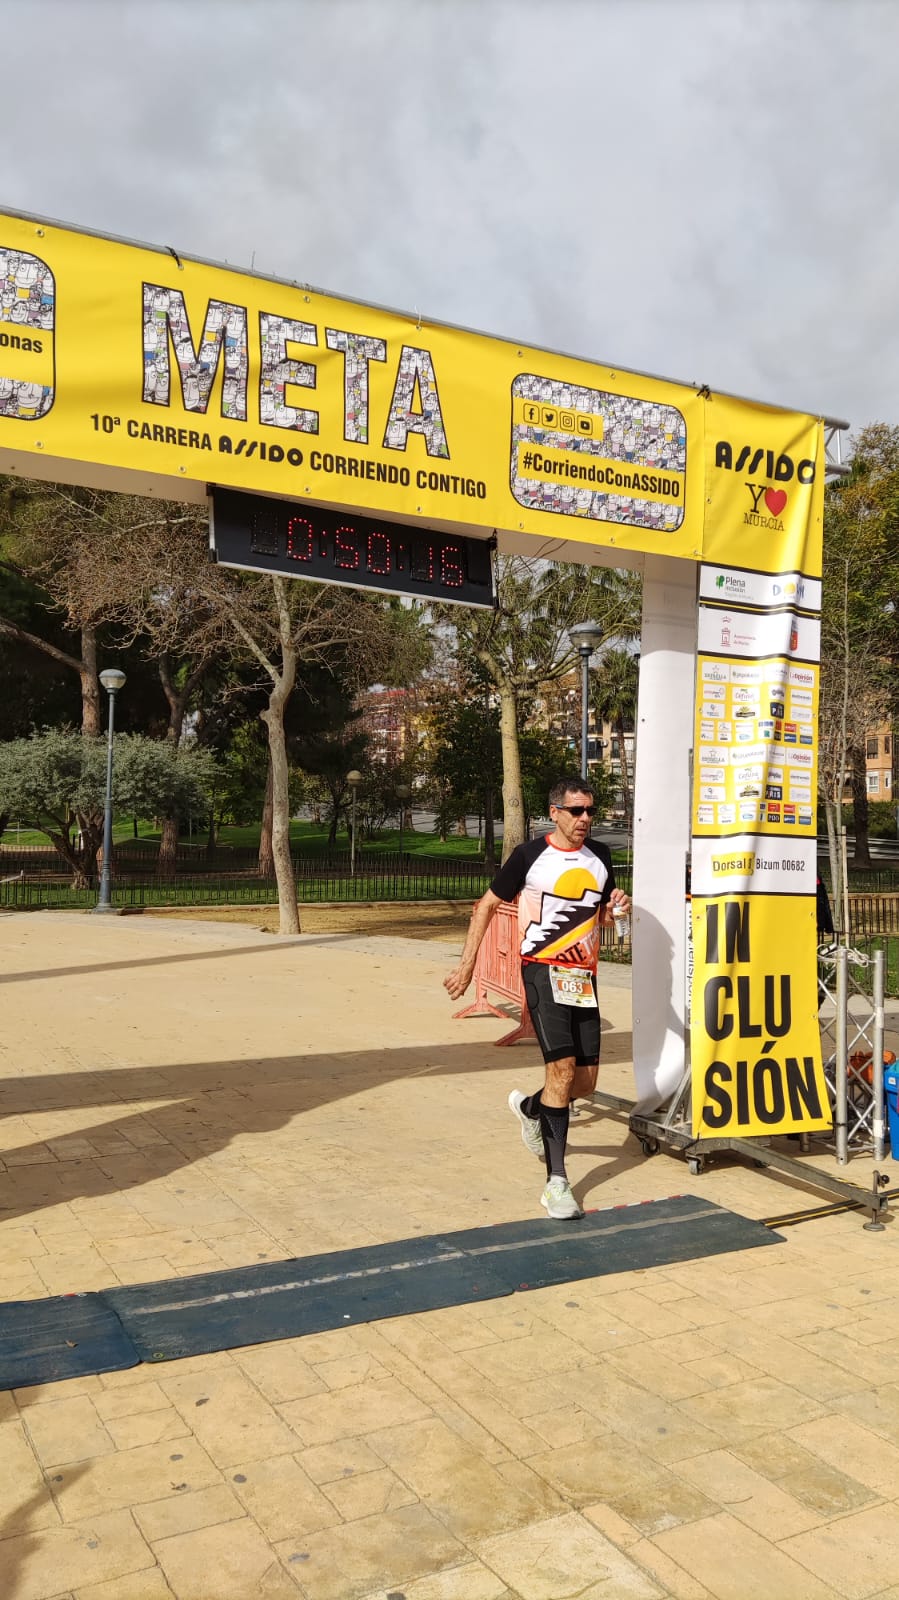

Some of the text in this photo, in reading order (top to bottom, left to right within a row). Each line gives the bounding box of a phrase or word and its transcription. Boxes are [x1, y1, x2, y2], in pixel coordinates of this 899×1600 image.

[142, 282, 450, 460] META
[127, 420, 213, 451] CARRERA
[218, 435, 304, 467] ASSIDO
[310, 451, 411, 487] CORRIENDO
[416, 470, 487, 499] CONTIGO
[523, 452, 680, 498] #CorriendoConASSIDO
[715, 441, 816, 484] ASSIDO
[743, 513, 785, 532] MURCIA
[726, 576, 746, 588] Plena
[712, 858, 745, 872] Dorsal
[756, 859, 780, 870] Bizum
[782, 860, 806, 872] 00682
[705, 902, 750, 963] IN
[562, 981, 583, 994] 063
[703, 974, 792, 1042] CLU
[700, 1041, 823, 1129] SIÓN
